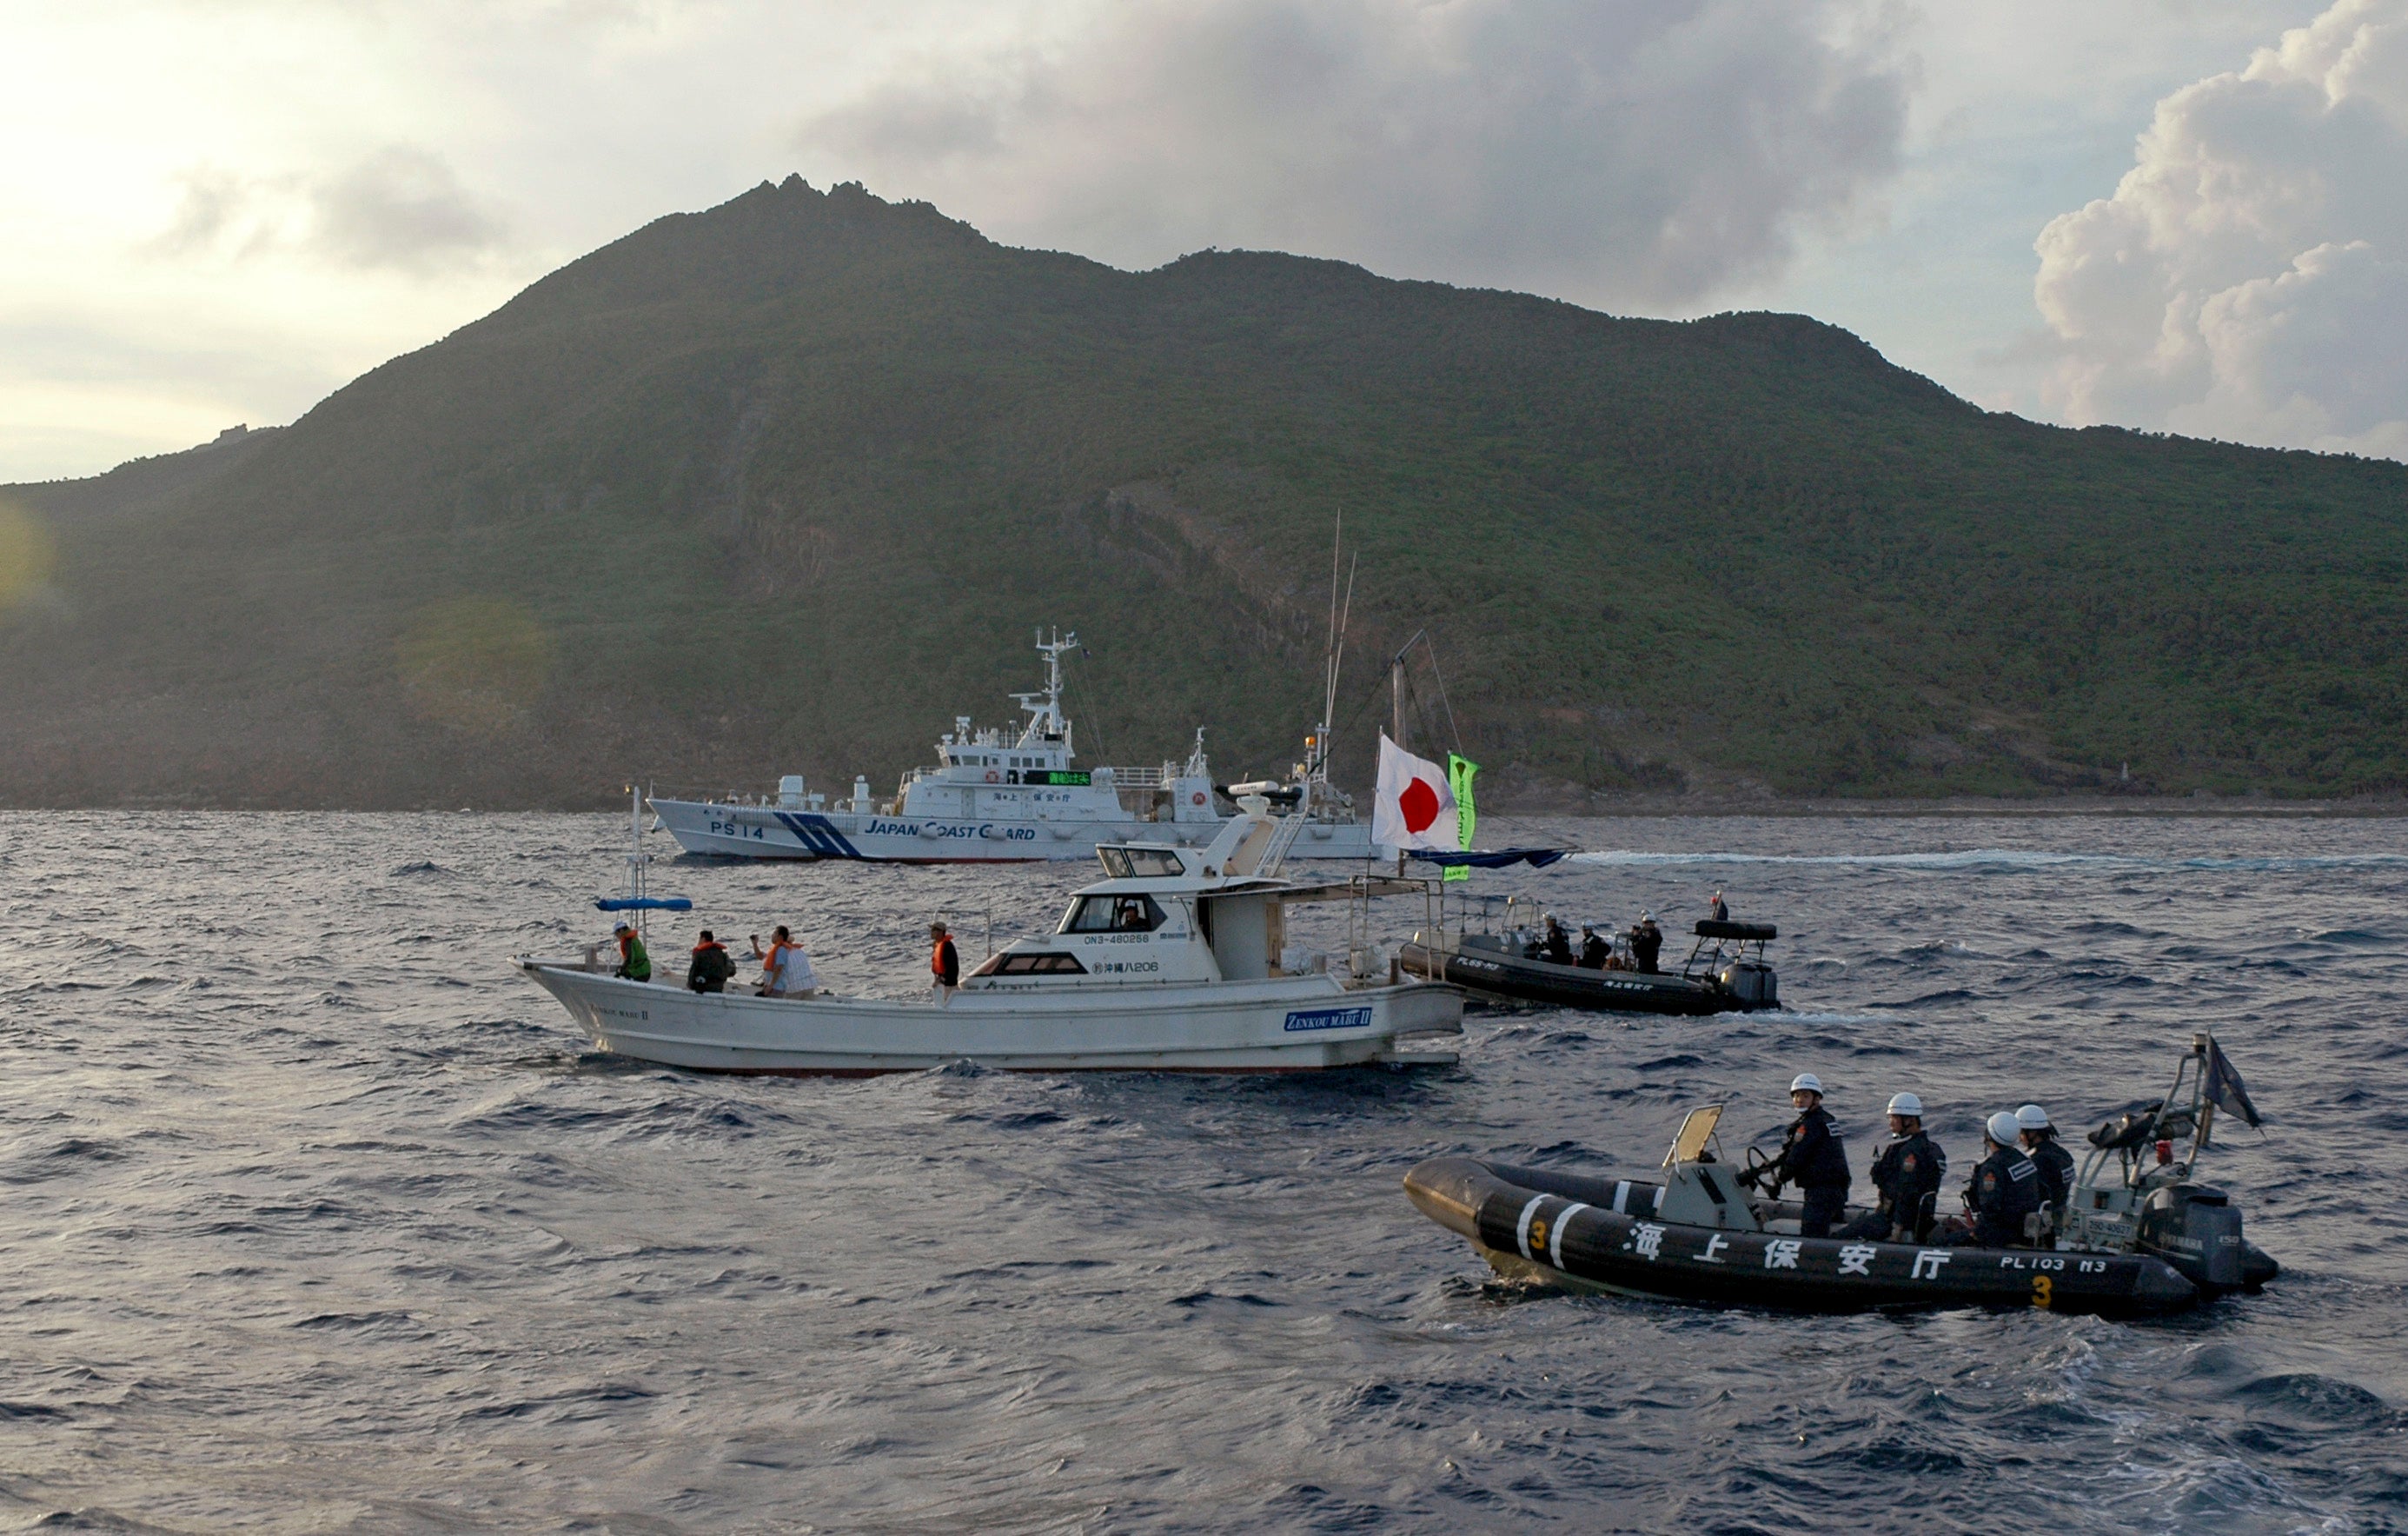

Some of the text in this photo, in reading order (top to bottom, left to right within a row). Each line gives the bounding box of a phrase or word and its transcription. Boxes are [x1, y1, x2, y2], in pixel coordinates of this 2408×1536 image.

[865, 820, 919, 836] JAPAN
[978, 824, 1035, 840] GARD
[1287, 1014, 1329, 1029] ZENKOU
[1330, 1014, 1359, 1027] MARU
[1530, 1220, 1546, 1250] 3
[1622, 1221, 1953, 1280] 海上保安庁
[2032, 1274, 2052, 1307] 3
